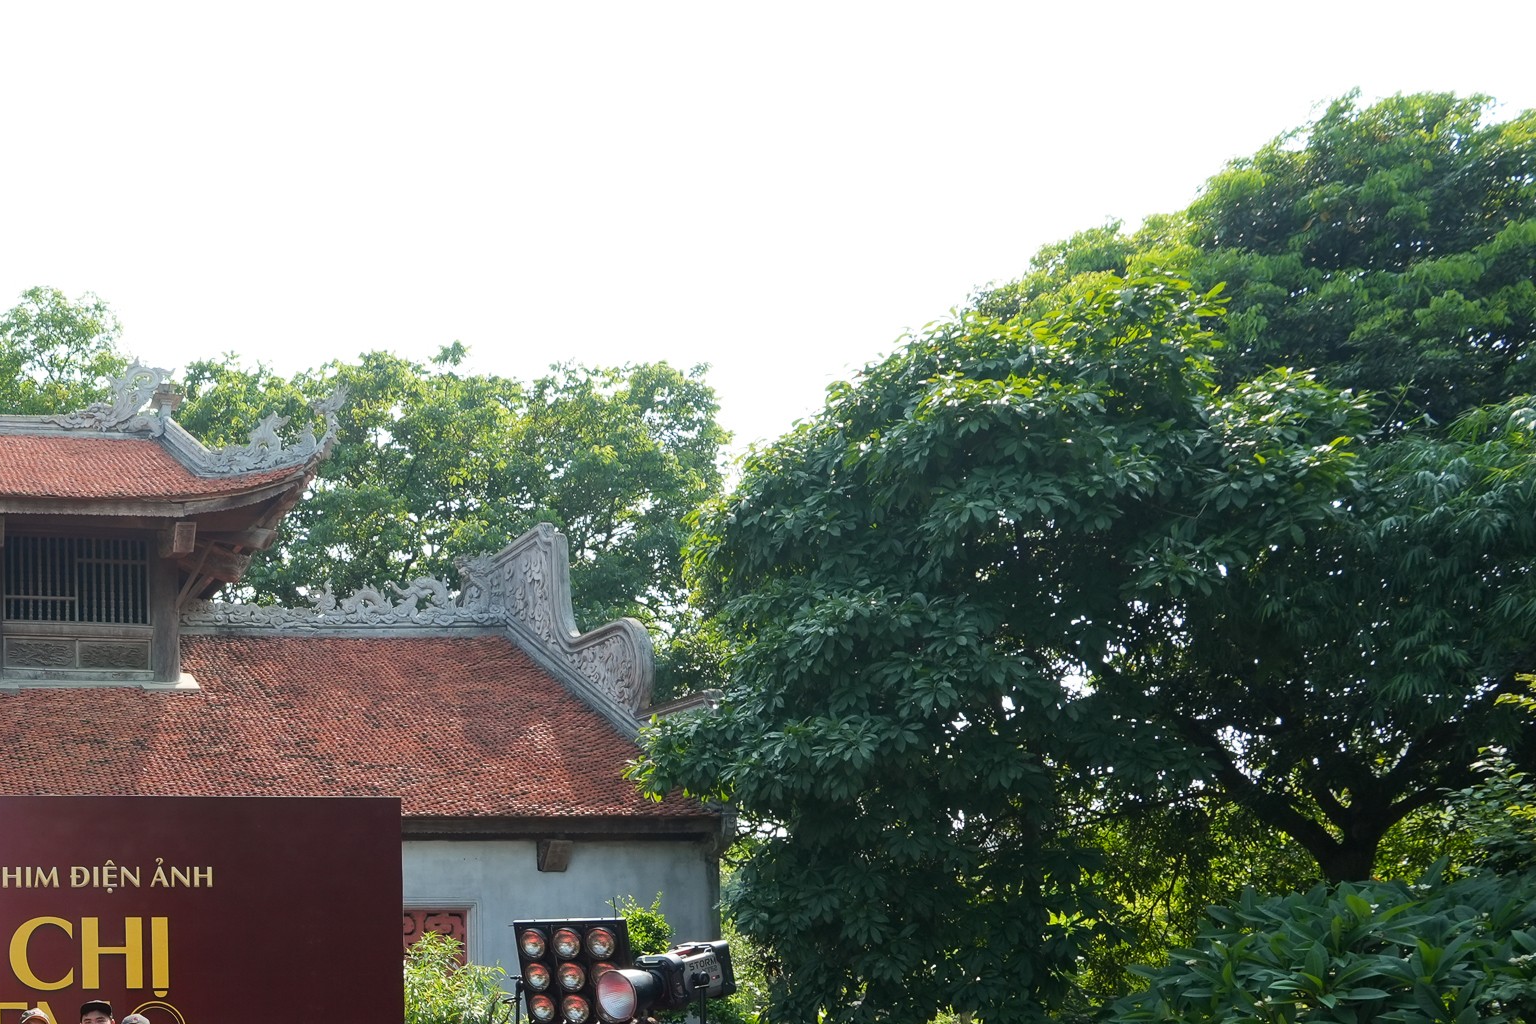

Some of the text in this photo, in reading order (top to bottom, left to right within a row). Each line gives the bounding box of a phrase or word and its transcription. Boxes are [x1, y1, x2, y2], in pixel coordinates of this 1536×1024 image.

[70, 860, 140, 893] ĐIỆN
[151, 857, 213, 888] ẢNH
[9, 916, 169, 998] CHỊ
[689, 957, 717, 971] STORM
